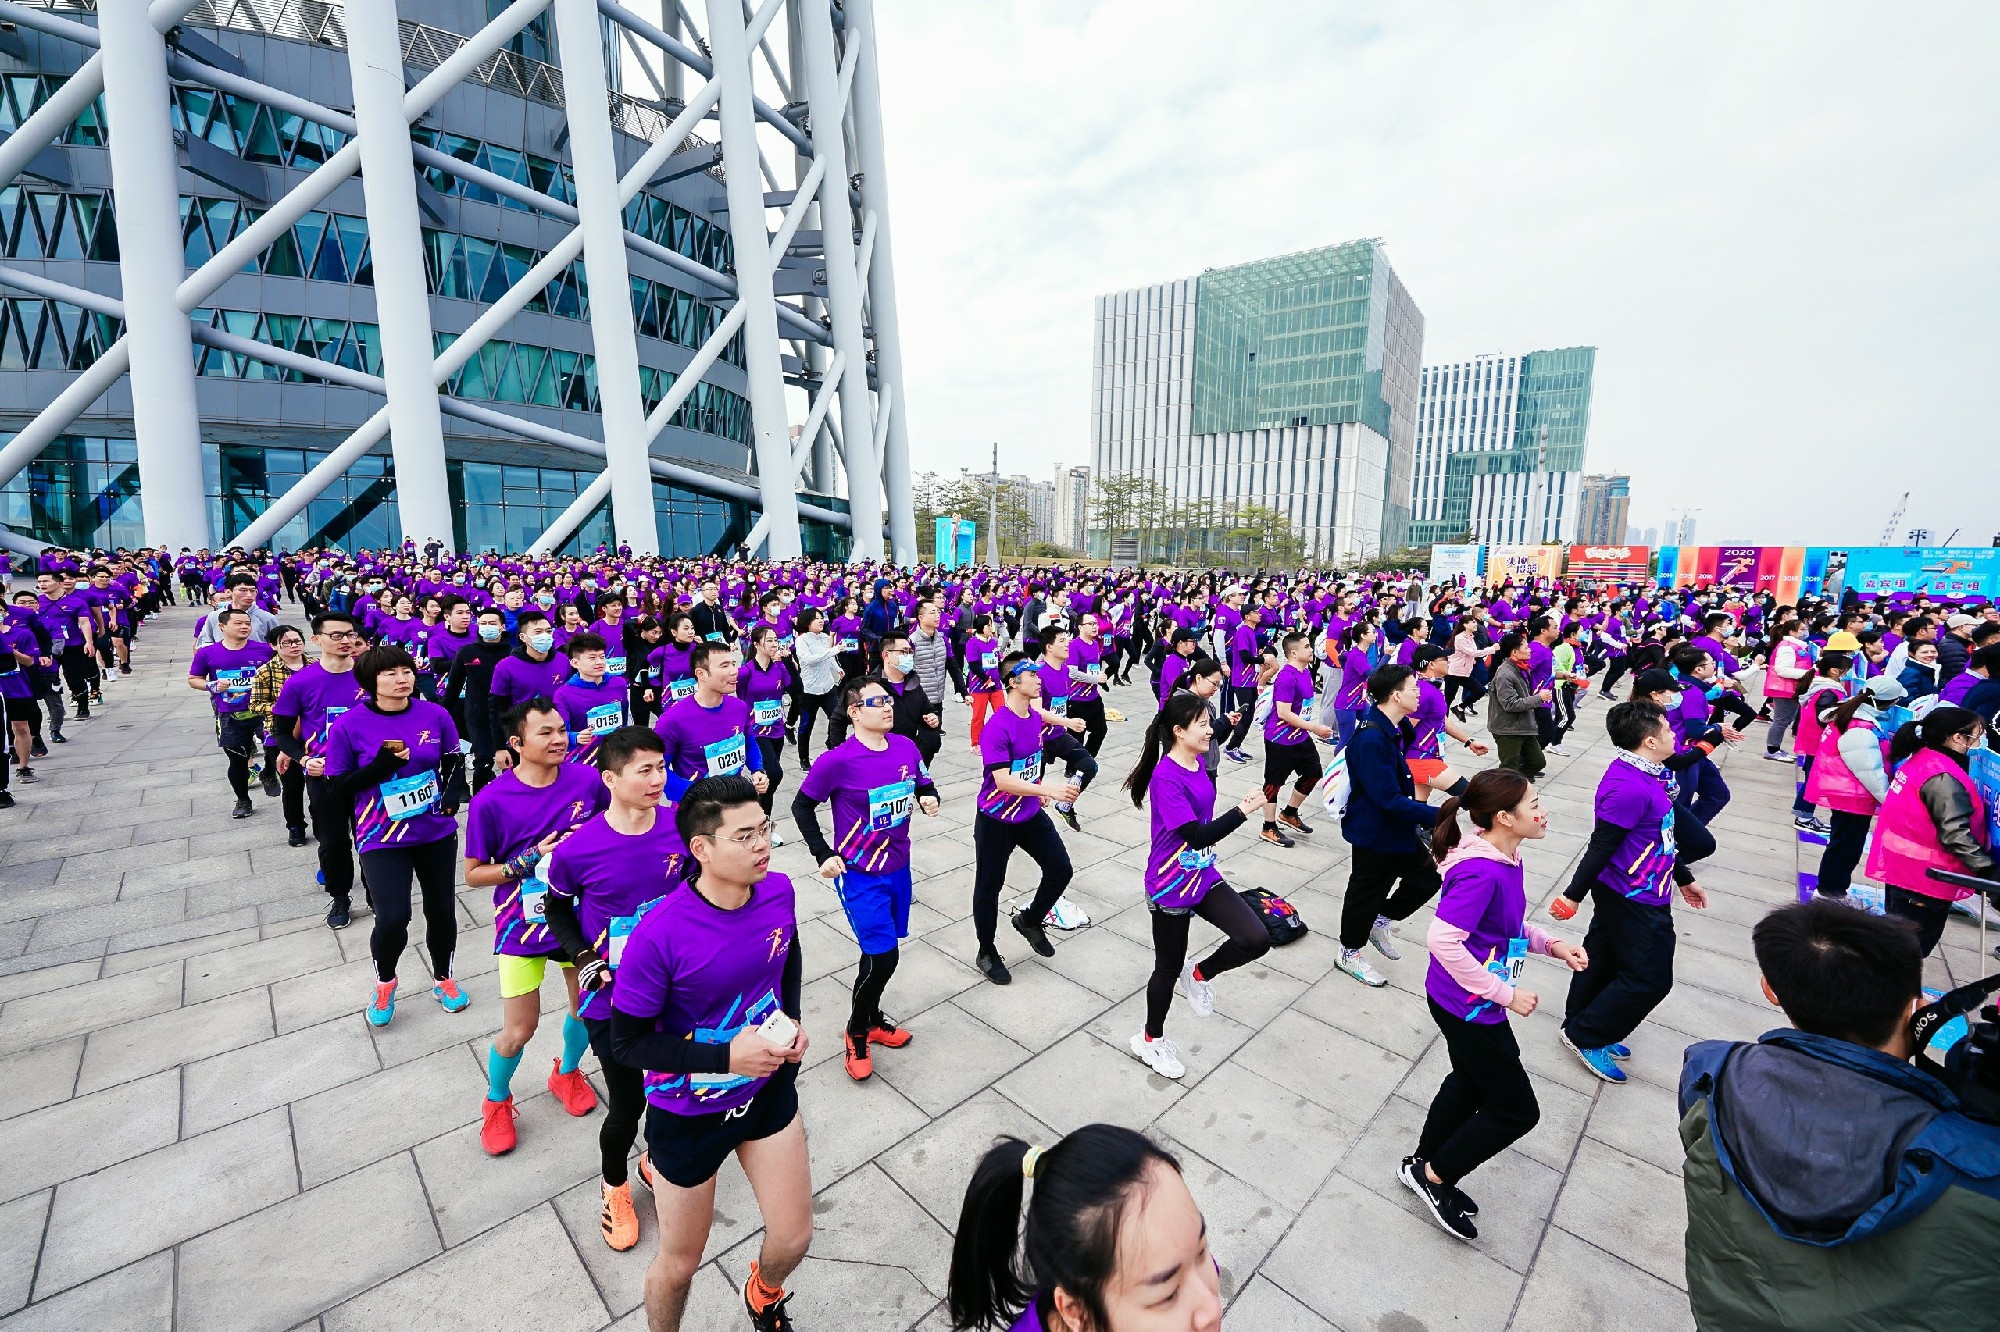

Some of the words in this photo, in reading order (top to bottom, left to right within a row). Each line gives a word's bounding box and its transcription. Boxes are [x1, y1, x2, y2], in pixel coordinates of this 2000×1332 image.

[1760, 574, 1776, 582] 2017
[1804, 575, 1820, 583] 2019
[1865, 579, 1906, 588] 嘉宾组
[1934, 581, 1980, 591] 嘉宾组
[677, 685, 696, 697] 0233
[596, 713, 619, 728] 0155
[717, 749, 741, 770] 0231
[398, 784, 433, 808] 1160
[1913, 1011, 1938, 1041] SONY
